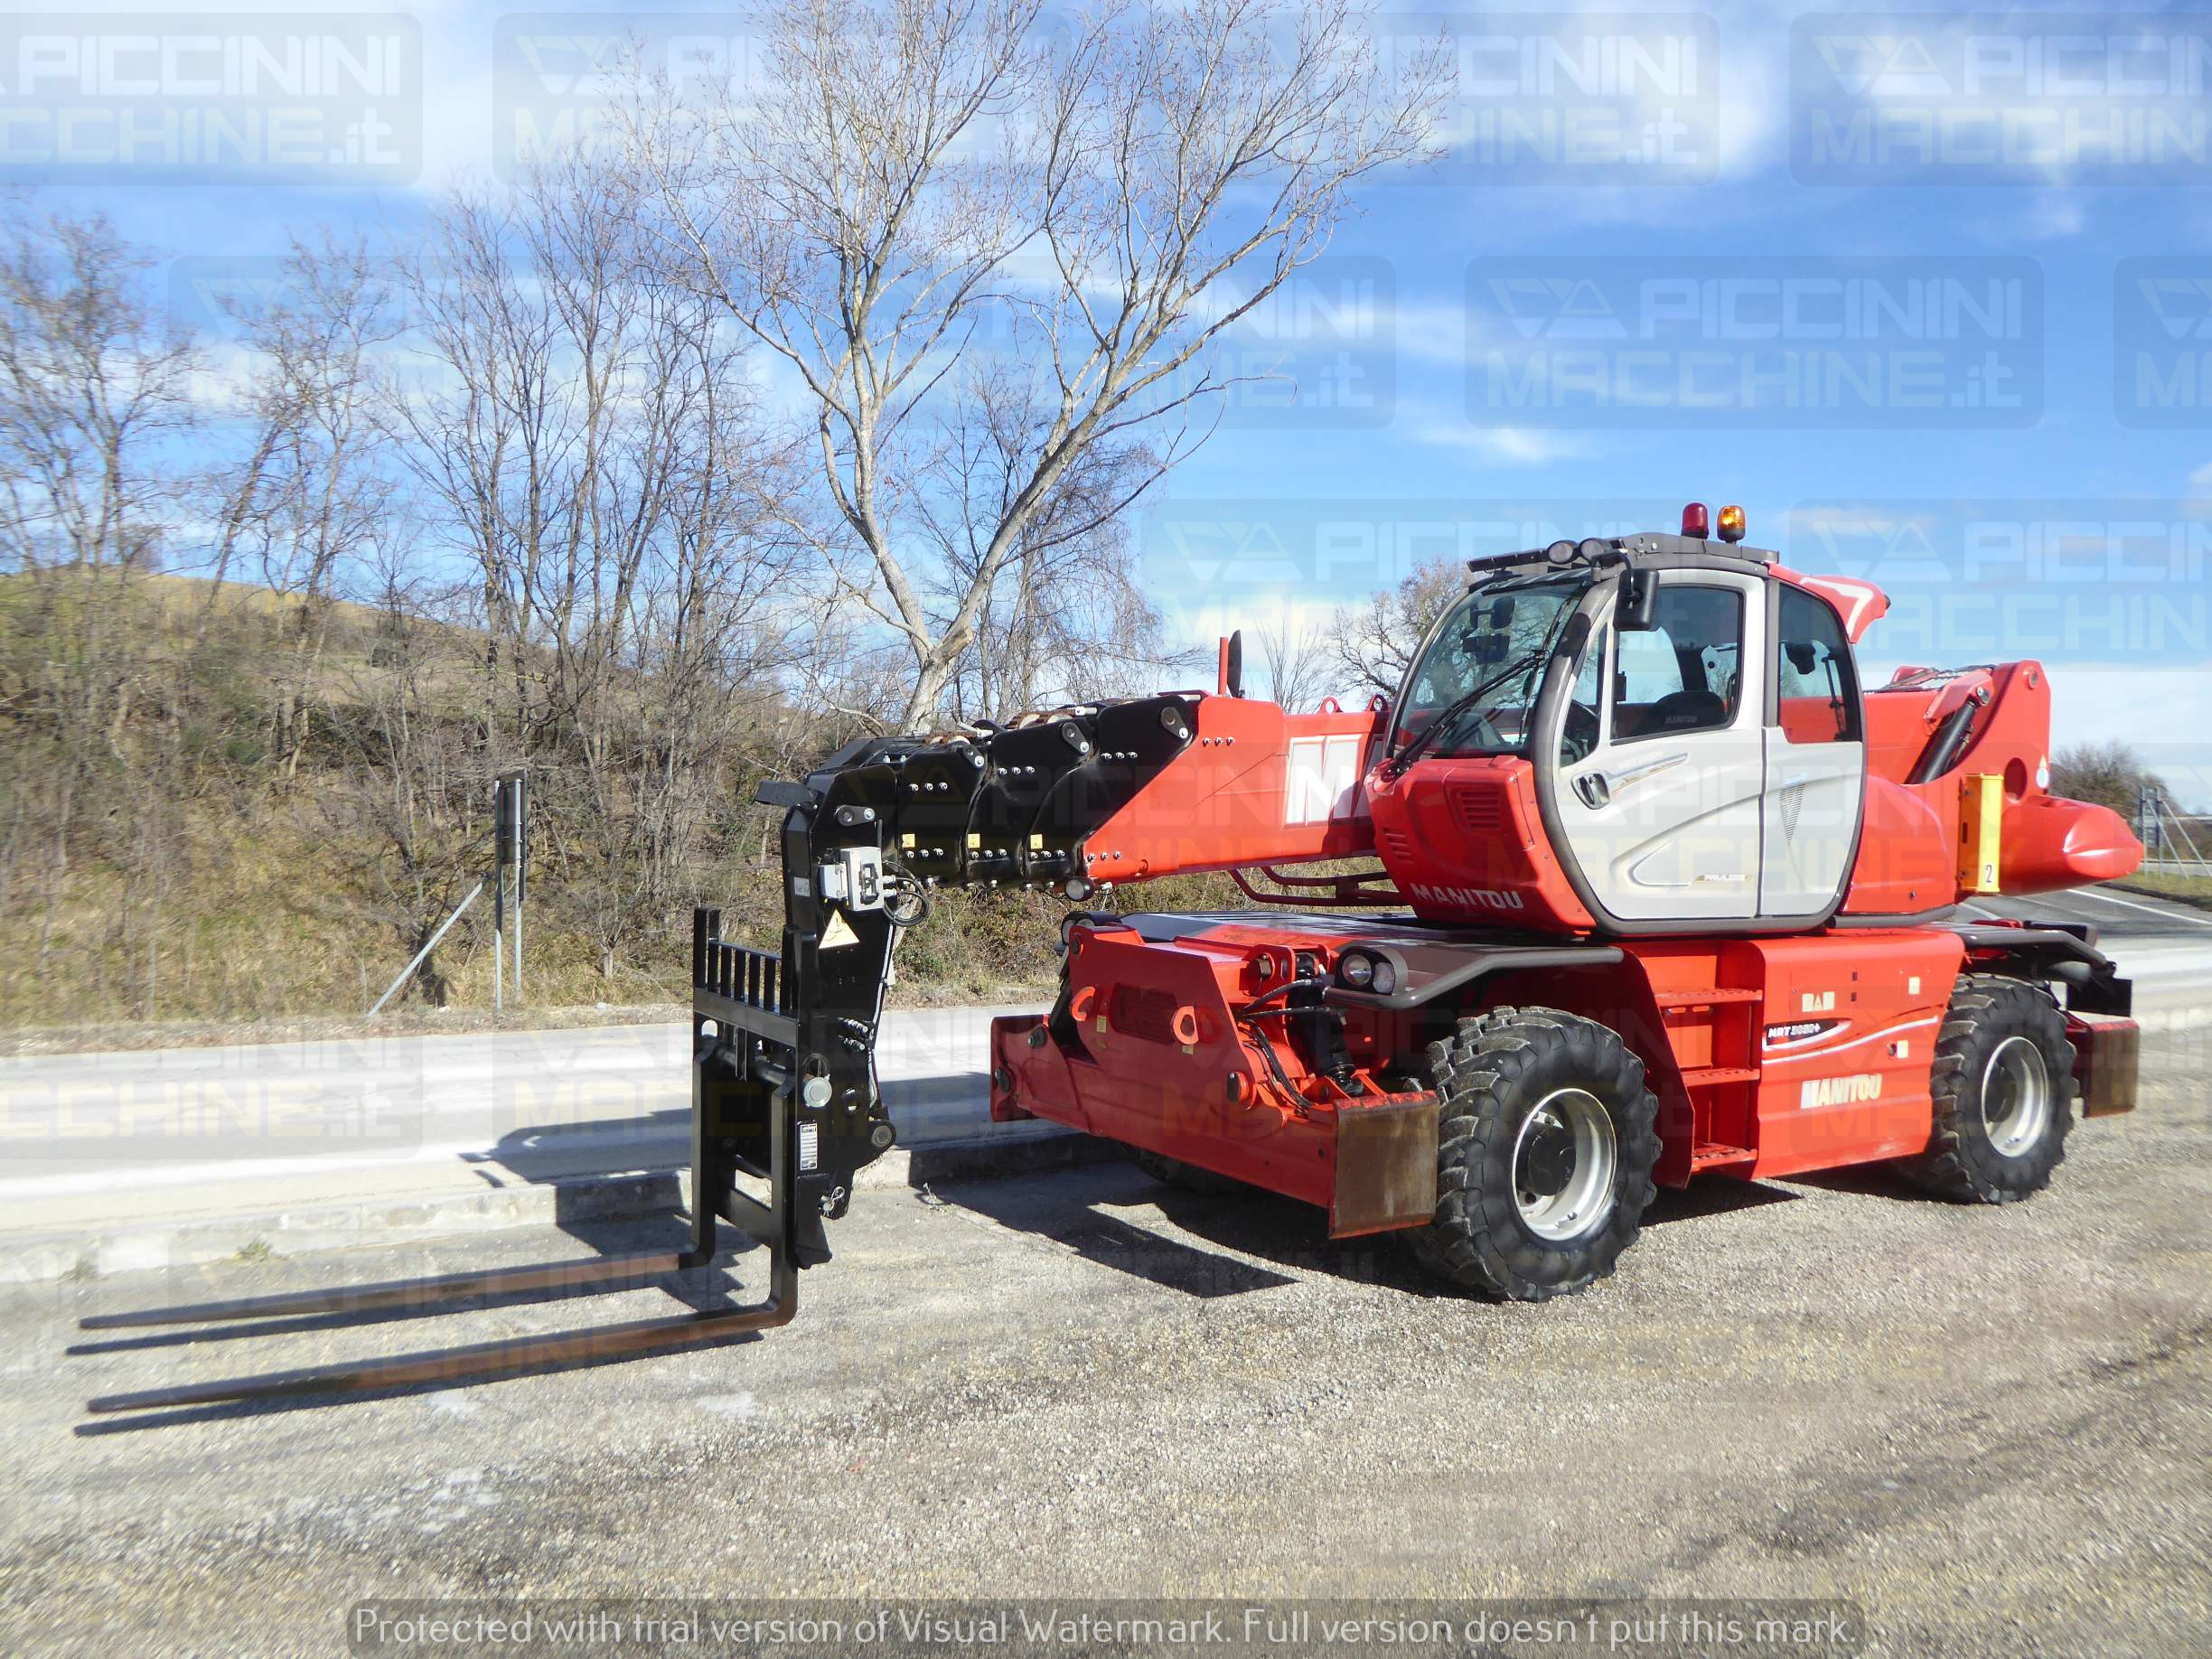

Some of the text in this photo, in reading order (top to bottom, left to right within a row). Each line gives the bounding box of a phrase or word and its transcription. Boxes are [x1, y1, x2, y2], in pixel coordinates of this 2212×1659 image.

[1985, 864, 1992, 884] 2
[1410, 882, 1524, 910] MANITOU
[1800, 1073, 1883, 1110] MANITOU
